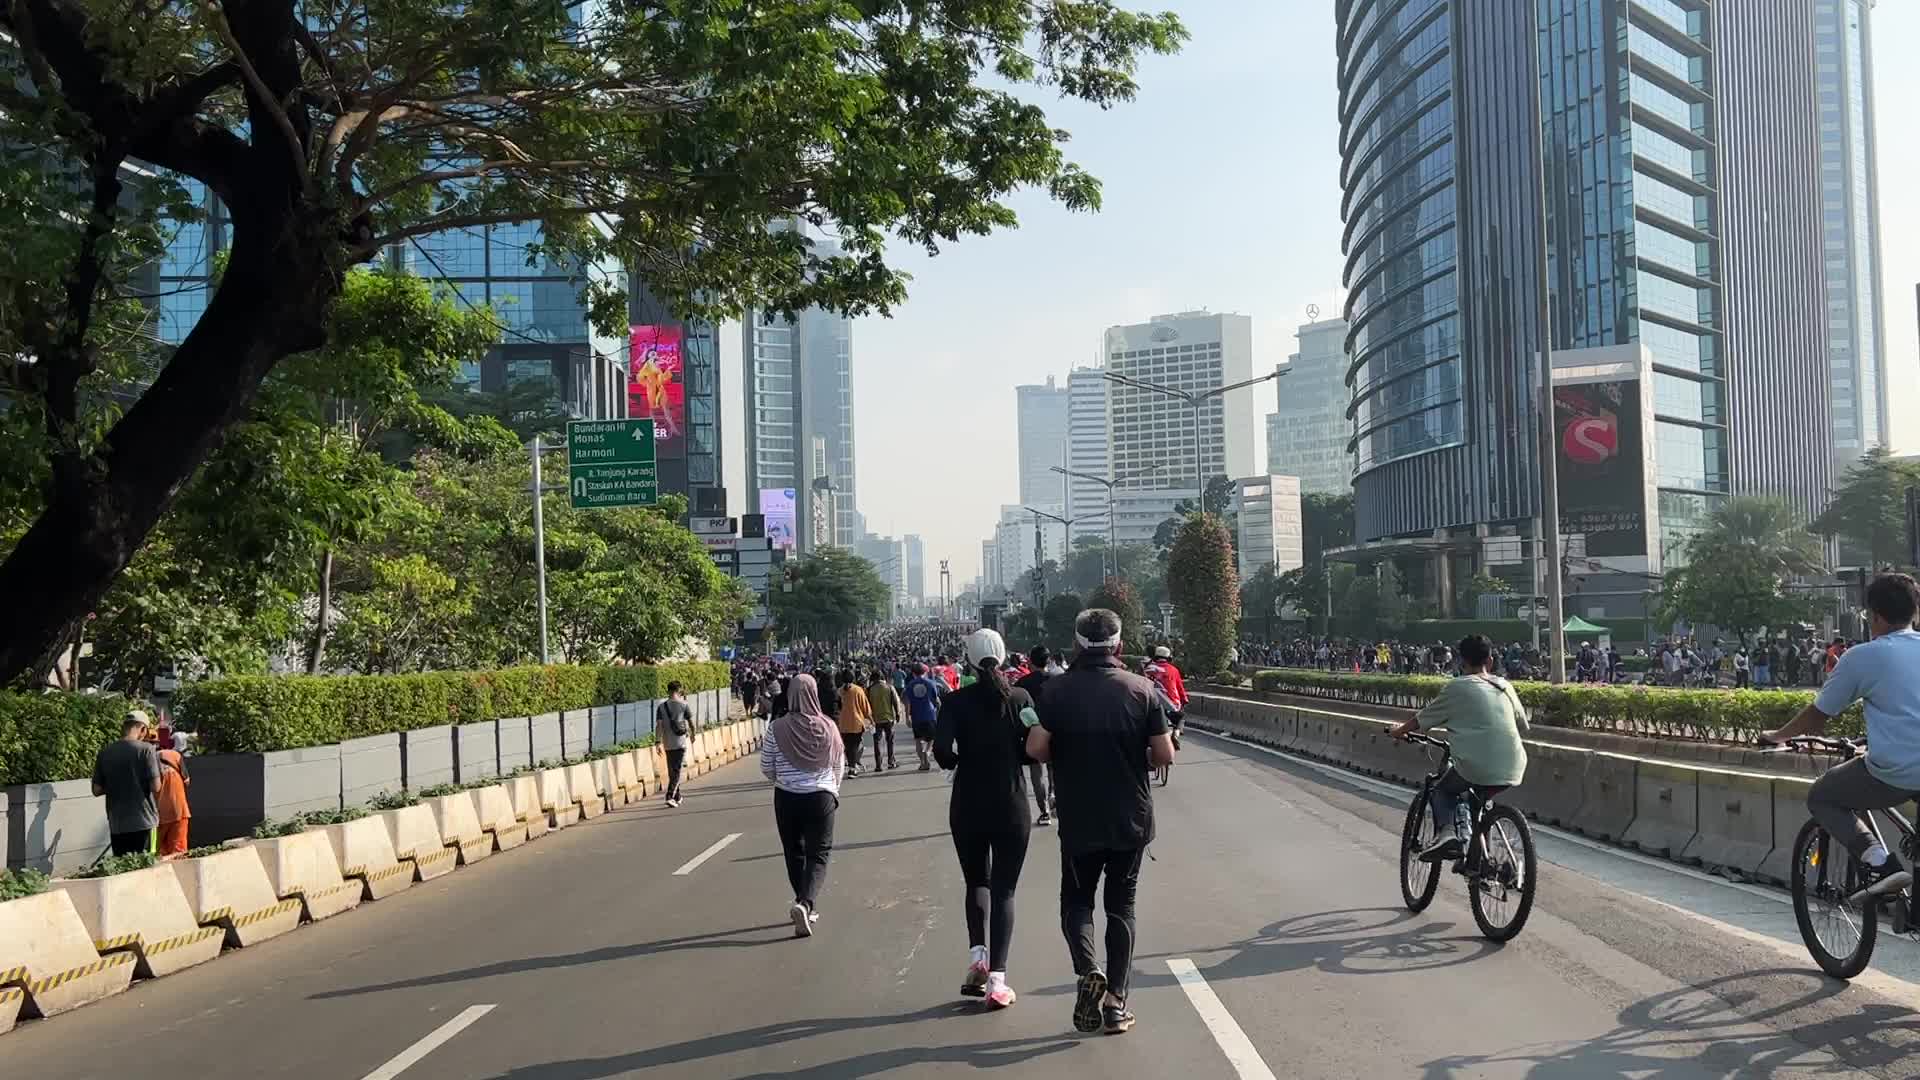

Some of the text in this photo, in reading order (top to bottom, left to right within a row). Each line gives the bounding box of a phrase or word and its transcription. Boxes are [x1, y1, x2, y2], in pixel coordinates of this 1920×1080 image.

[574, 423, 615, 433] Bundaran
[574, 433, 605, 444] Monas
[575, 447, 615, 458] Harmoni
[627, 467, 654, 477] Karang
[614, 480, 625, 489] KA
